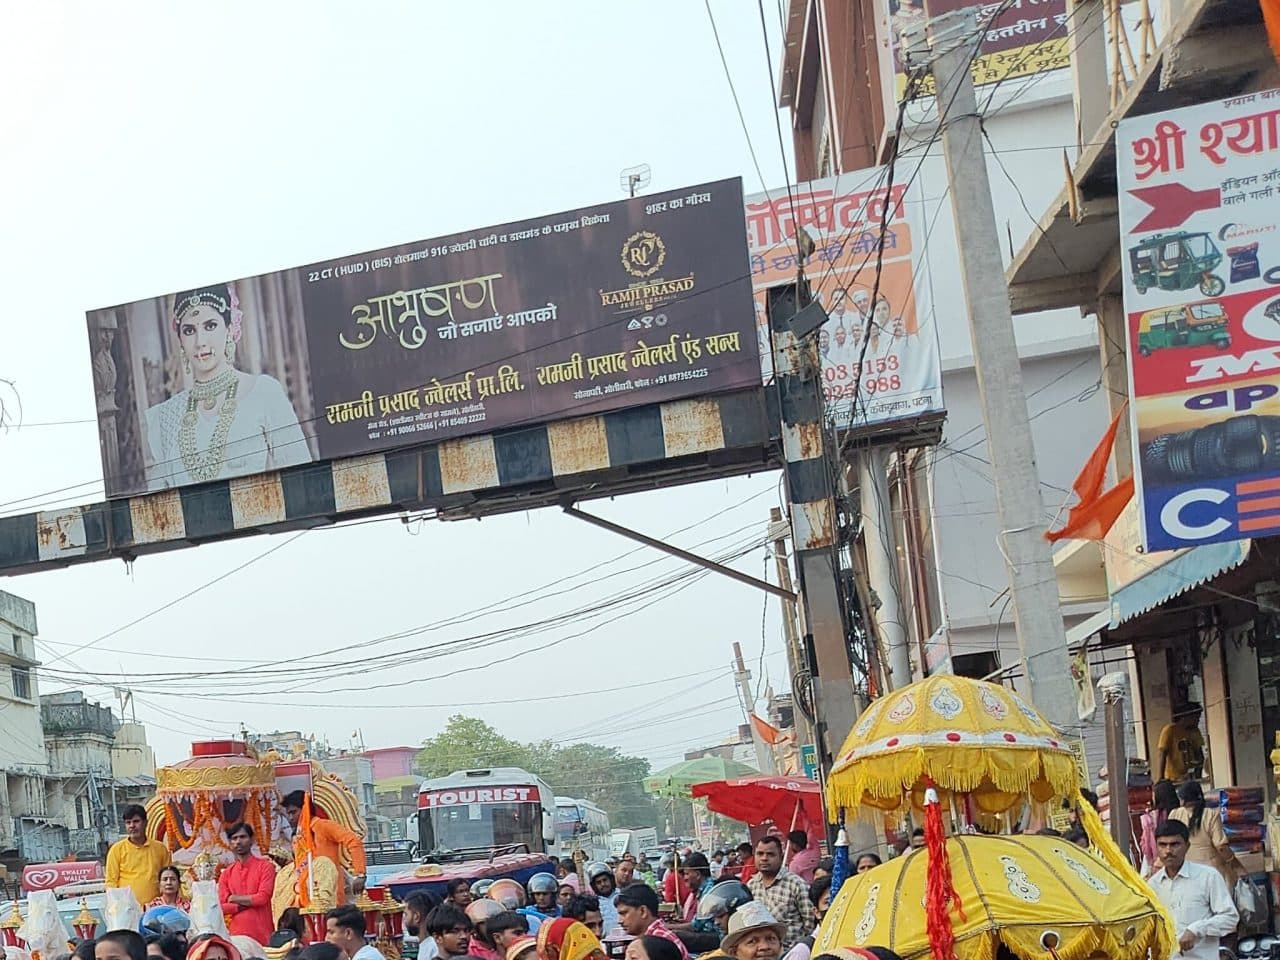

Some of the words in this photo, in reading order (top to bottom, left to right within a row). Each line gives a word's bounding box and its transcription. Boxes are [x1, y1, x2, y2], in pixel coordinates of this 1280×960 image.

[1131, 119, 1187, 180] श्री
[645, 200, 668, 215] शहर
[669, 197, 684, 210] का
[746, 183, 908, 249] ॉस्पिटल
[1222, 190, 1247, 206] वाले
[308, 271, 320, 282] 22
[321, 268, 333, 279] CT
[340, 262, 364, 275] HUID
[371, 257, 392, 271] (BIS)
[431, 245, 448, 257] 916
[601, 289, 641, 306] RAMJI
[643, 279, 695, 298] PRASAD
[437, 319, 459, 341] जो
[460, 312, 504, 336] सजाएं
[506, 302, 558, 328] आपको
[536, 352, 584, 386] रामजी
[587, 351, 629, 378] प्रसाद
[630, 334, 680, 369] ज्वेलर्स
[681, 332, 702, 365] एंड
[705, 331, 741, 356] सन्स
[325, 390, 375, 425] रामजी
[378, 389, 421, 417] प्रसाद
[423, 371, 475, 406] ज्वेलर्स
[426, 788, 530, 807] TOURIST
